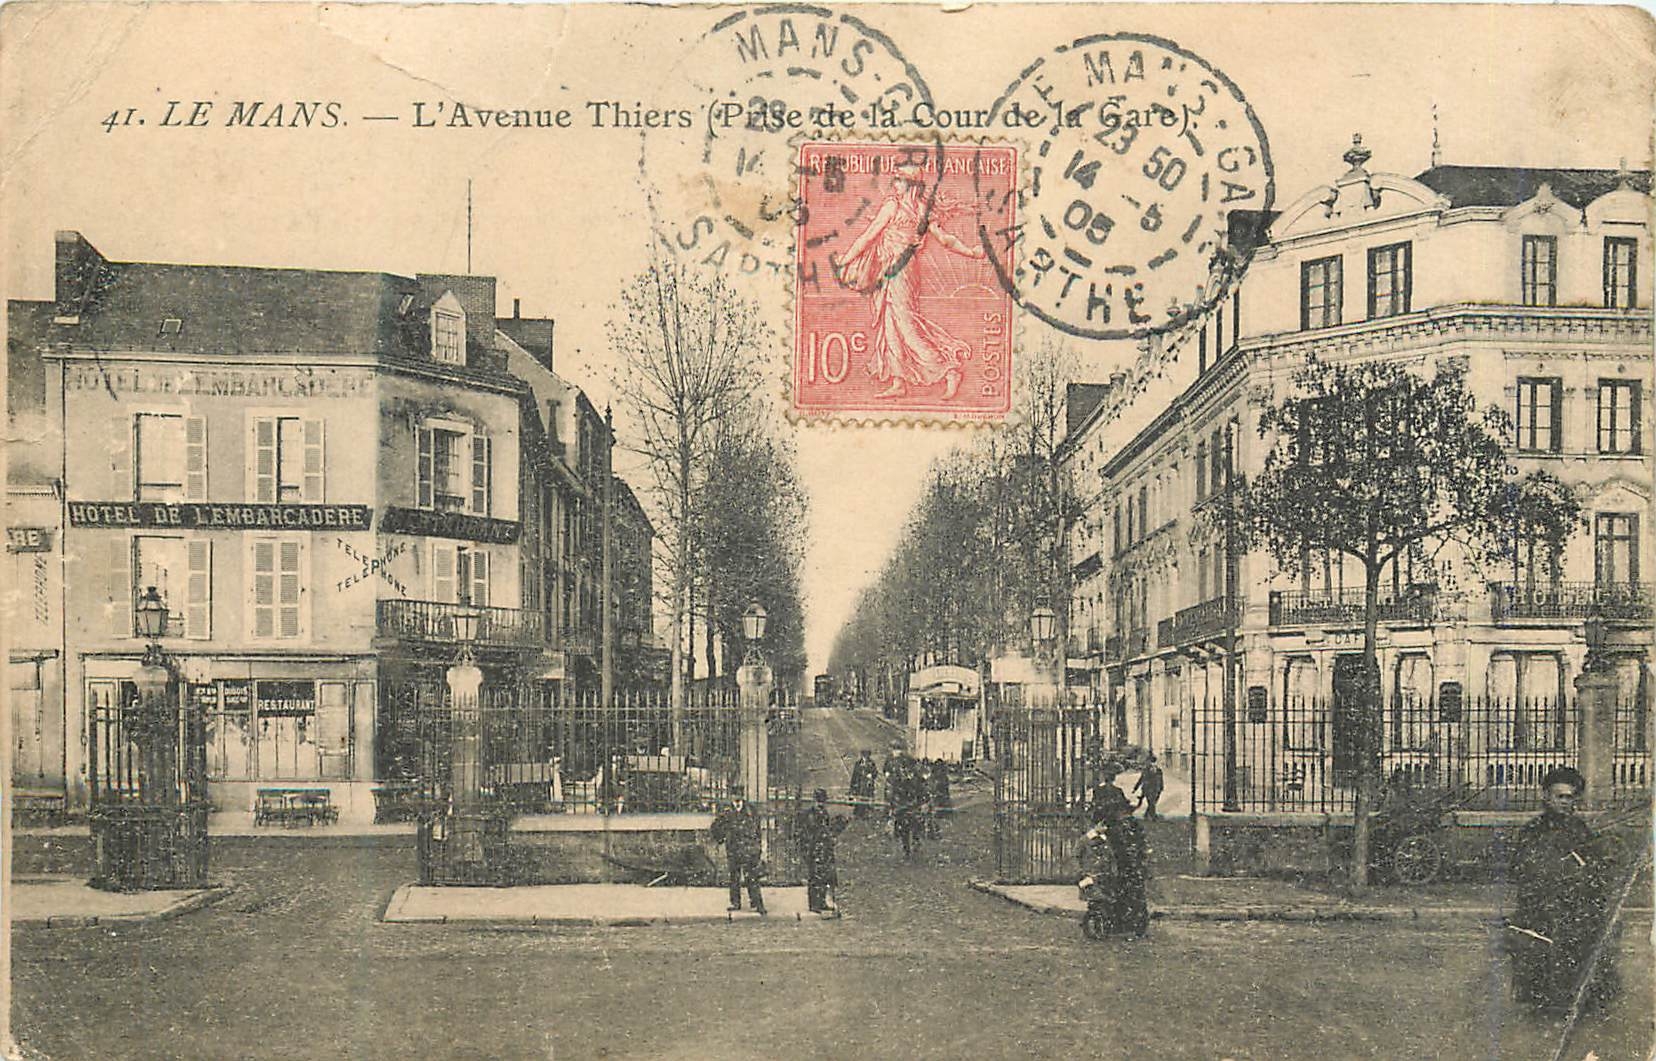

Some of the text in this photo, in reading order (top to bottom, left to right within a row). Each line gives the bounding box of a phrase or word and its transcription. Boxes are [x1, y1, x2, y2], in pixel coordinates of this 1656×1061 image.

[1142, 146, 1188, 191] 50
[982, 311, 1002, 398] POSTES
[153, 506, 181, 524] DE
[258, 699, 314, 711] RESTAURANT
